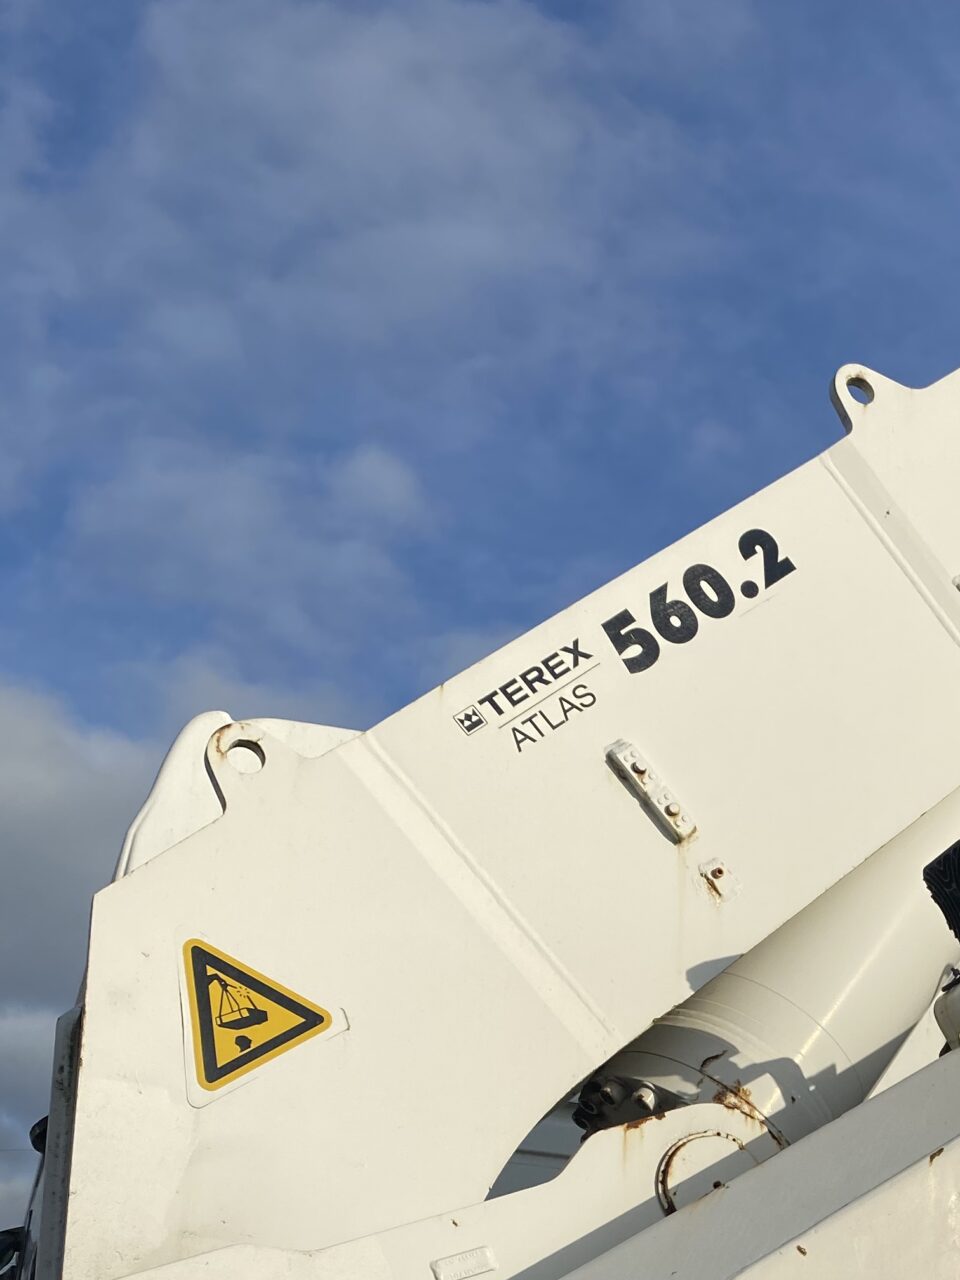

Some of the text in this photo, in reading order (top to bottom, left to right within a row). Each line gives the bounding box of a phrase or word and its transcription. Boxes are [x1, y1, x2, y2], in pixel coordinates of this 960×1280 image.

[600, 528, 797, 675] 560.2
[478, 638, 594, 716] TEREX
[510, 683, 597, 753] ATLAS
